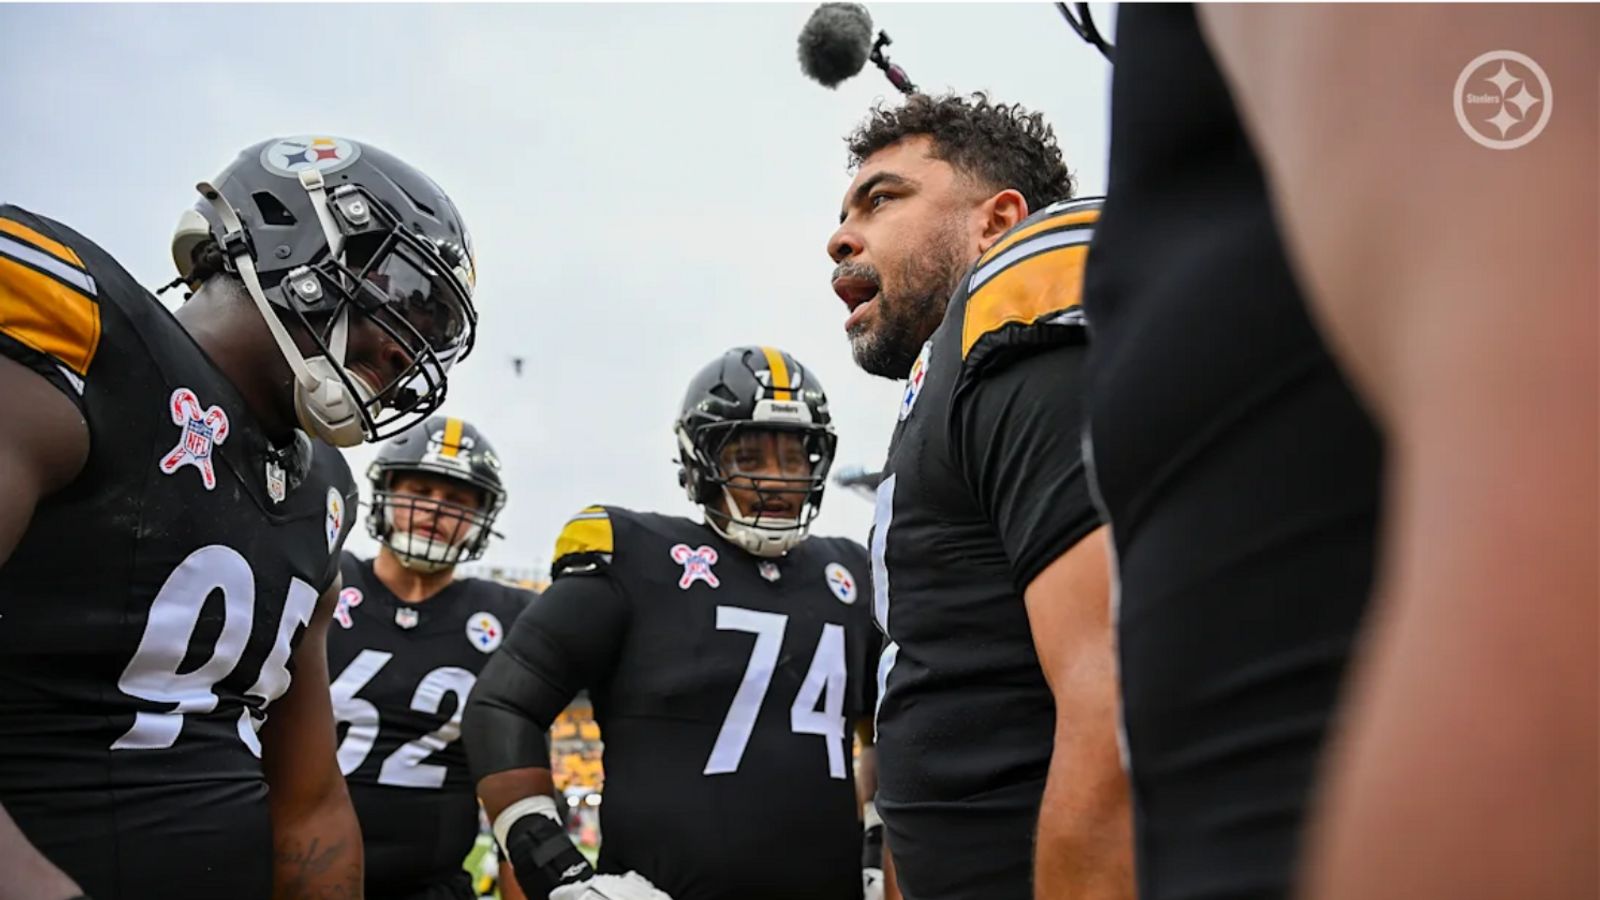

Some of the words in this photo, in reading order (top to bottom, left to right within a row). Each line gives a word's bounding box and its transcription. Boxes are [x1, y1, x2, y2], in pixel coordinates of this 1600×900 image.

[187, 431, 208, 456] NFL
[771, 403, 798, 413] Steelers
[329, 649, 477, 788] 62
[703, 605, 847, 779] 74
